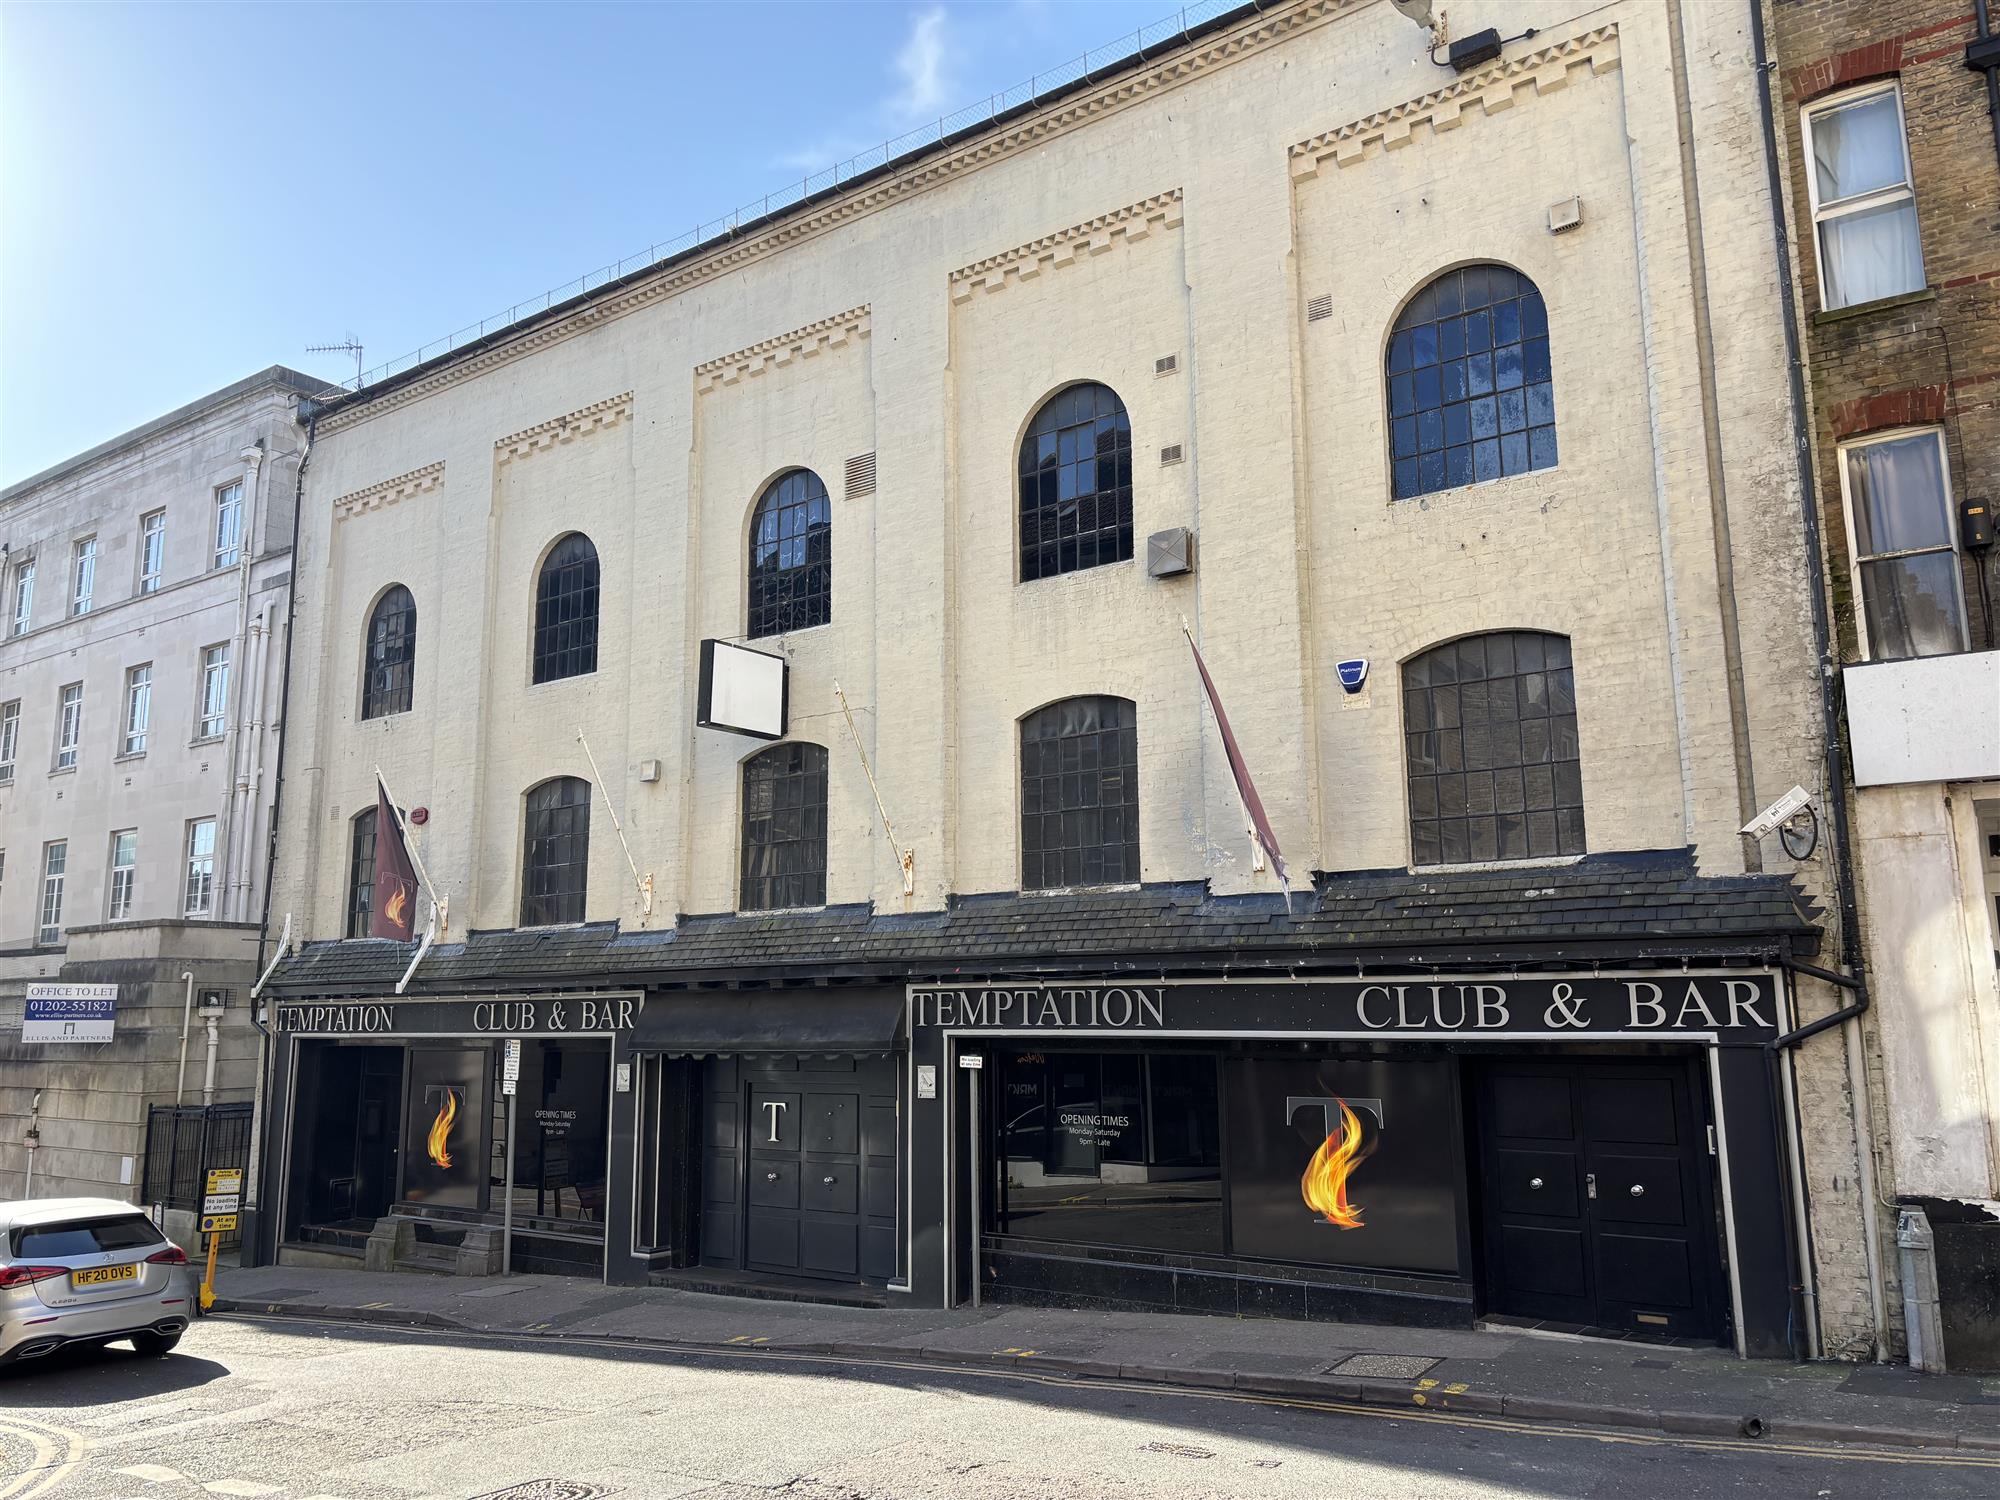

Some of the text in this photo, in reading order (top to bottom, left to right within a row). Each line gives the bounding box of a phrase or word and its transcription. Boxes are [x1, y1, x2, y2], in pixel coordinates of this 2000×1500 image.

[31, 987, 117, 996] OFFICE TO LET
[30, 1001, 113, 1011] 01202-551821
[912, 980, 1775, 1028] TEMPTATION CLUB & BAR
[277, 1000, 634, 1032] TEMPTATION CLUB & BAR
[535, 1110, 577, 1119] OPENING TIMES
[1060, 1114, 1129, 1127] OPENING TIMES
[762, 1102, 787, 1142] T
[1069, 1127, 1121, 1137] Monday-Saturday
[77, 1266, 133, 1284] HF20 OVS
